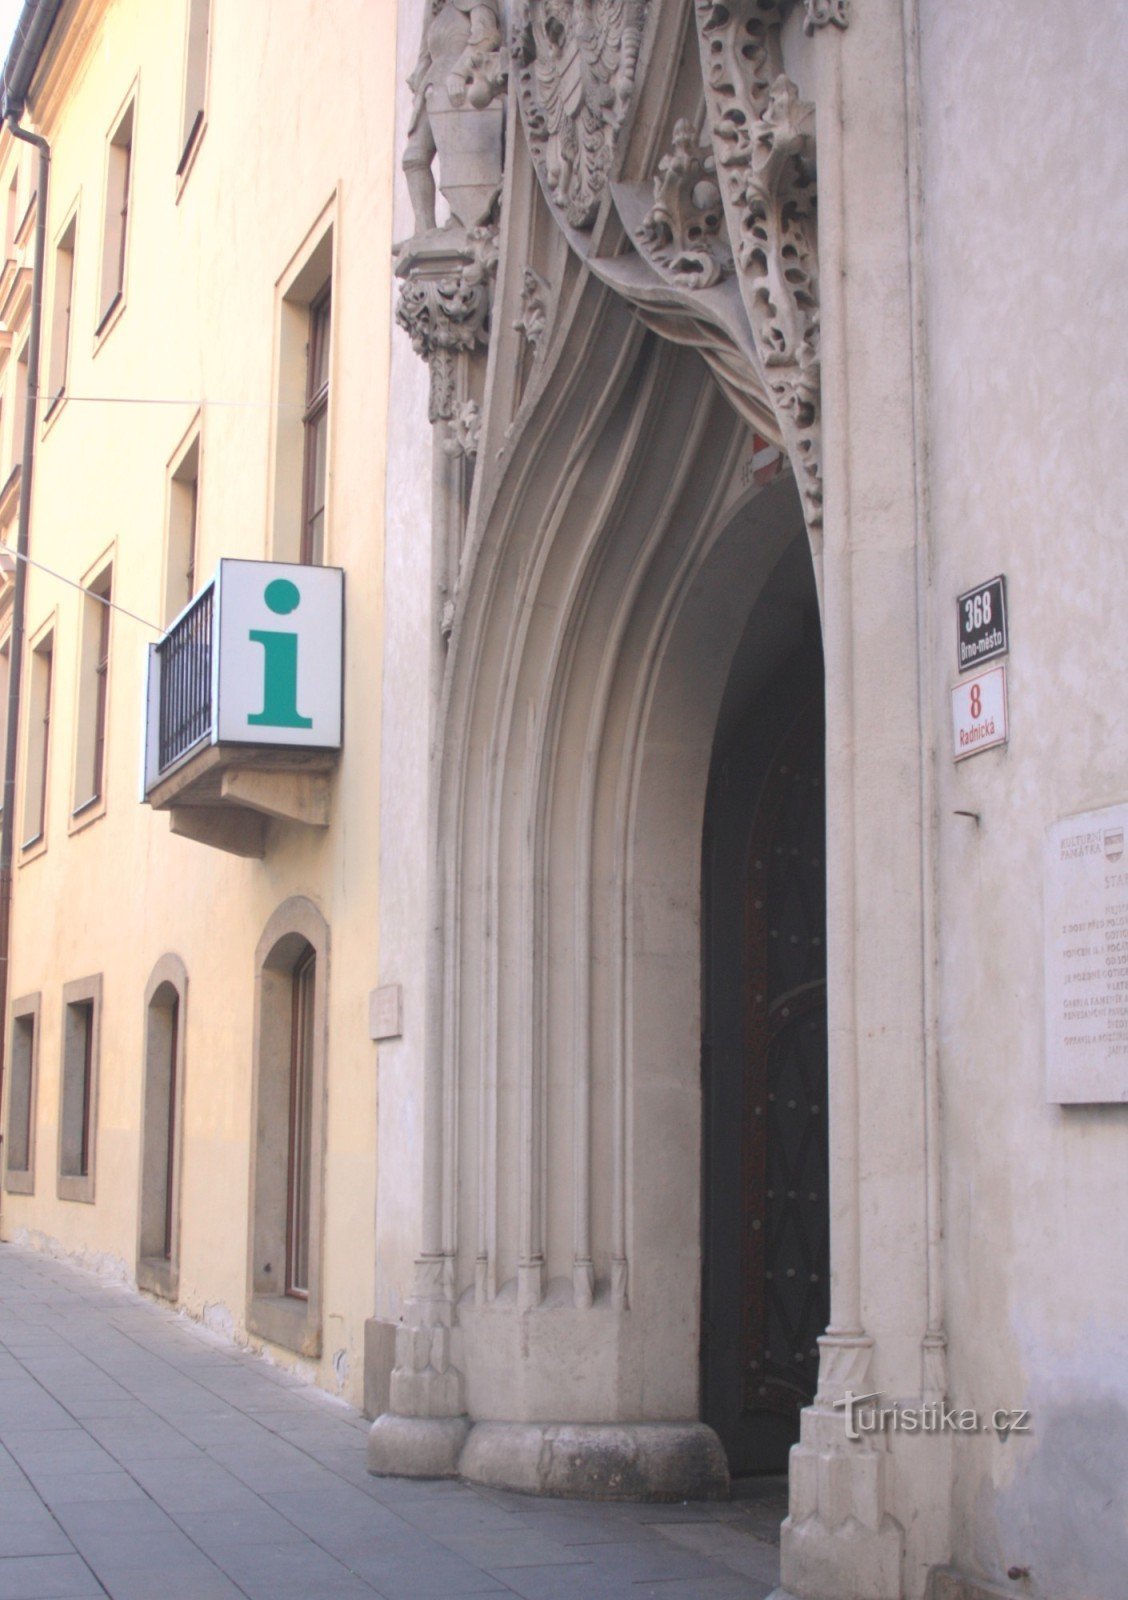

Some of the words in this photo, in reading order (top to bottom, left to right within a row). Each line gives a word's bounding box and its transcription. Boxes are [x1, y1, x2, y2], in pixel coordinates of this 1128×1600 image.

[965, 591, 992, 633] 368
[961, 627, 1002, 661] Brno-město
[970, 684, 981, 719] 8
[960, 716, 995, 747] Radnická
[1060, 828, 1102, 849] KULTURNÍ
[1060, 843, 1102, 860] PAMÁTKA
